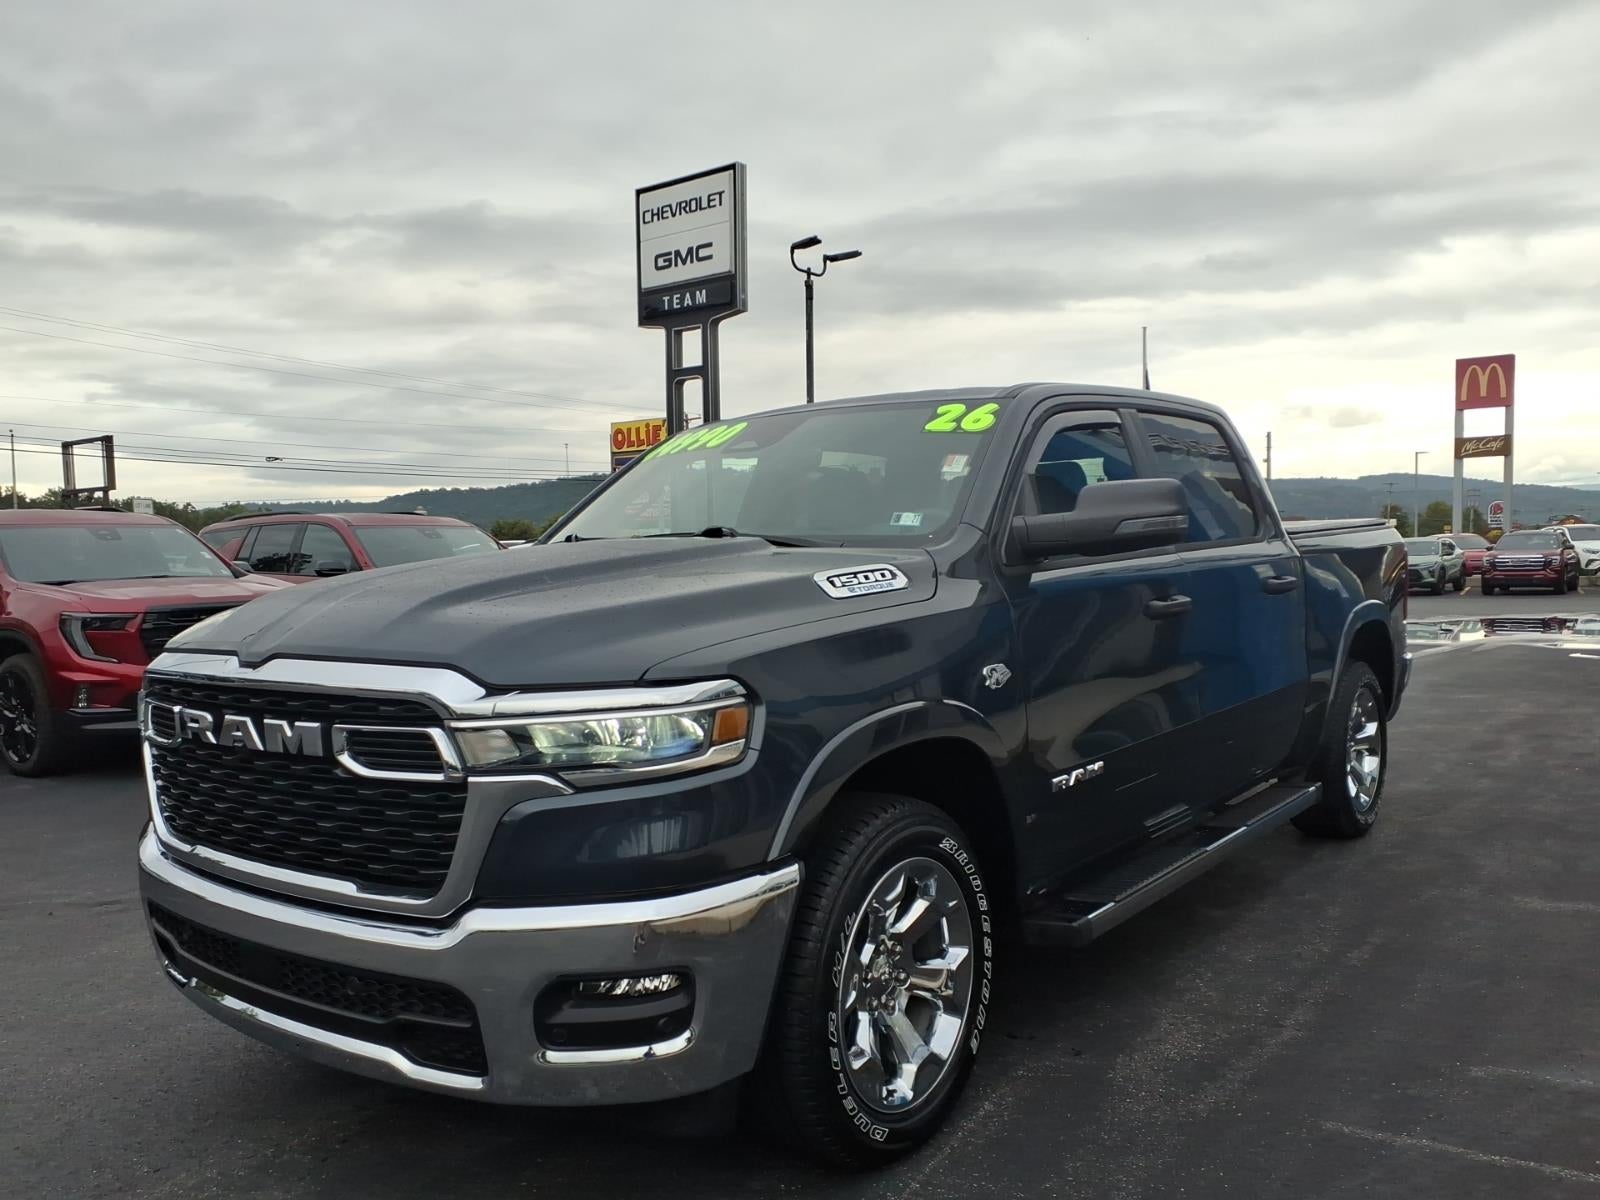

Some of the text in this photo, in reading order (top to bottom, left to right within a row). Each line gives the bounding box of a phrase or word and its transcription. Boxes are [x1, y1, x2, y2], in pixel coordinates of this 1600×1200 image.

[642, 190, 726, 225] CHEVROLET
[654, 241, 714, 271] GMC
[662, 289, 707, 311] TEAM
[924, 403, 1000, 432] 26
[829, 570, 892, 587] 1500
[181, 706, 324, 757] RAM
[1051, 761, 1105, 792] RAM
[939, 837, 993, 1055] BRIDGESTONE
[828, 1010, 889, 1142] DUELER
